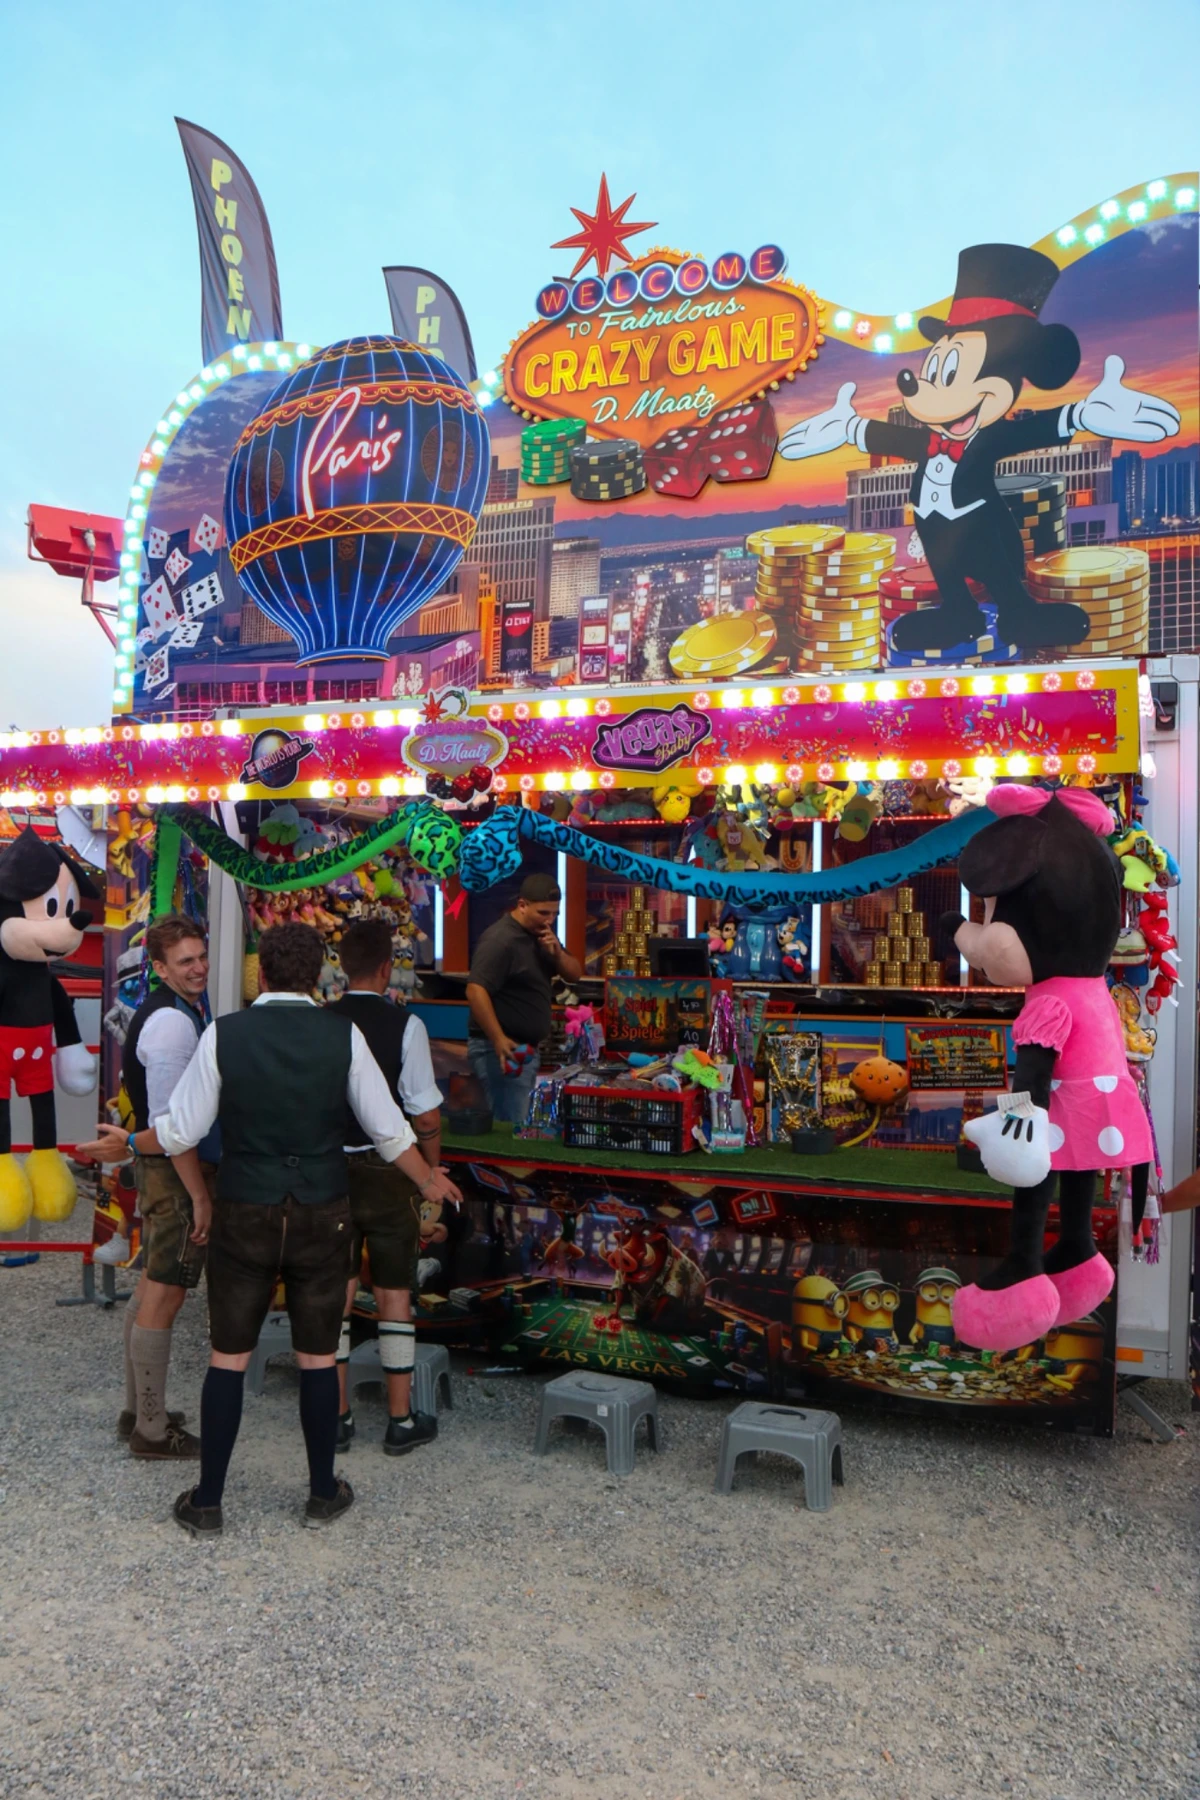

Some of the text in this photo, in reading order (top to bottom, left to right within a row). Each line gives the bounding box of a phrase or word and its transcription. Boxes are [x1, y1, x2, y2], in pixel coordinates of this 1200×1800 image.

[541, 247, 776, 313] WELCOME
[566, 321, 592, 339] TO
[524, 313, 797, 398] CRAZY GAME
[591, 385, 721, 424] D. Maatz
[302, 386, 403, 521] Paris
[254, 751, 278, 772] WORLD
[284, 740, 302, 758] YOURS
[419, 741, 491, 764] D. Maatz
[654, 723, 696, 766] Baby!
[611, 997, 658, 1012] 1 Spiel
[610, 1025, 662, 1040] 3 Spiele
[683, 1031, 700, 1042] 10
[824, 1110, 871, 1128] stpreise!
[539, 1347, 689, 1378] LAS VEGAS
